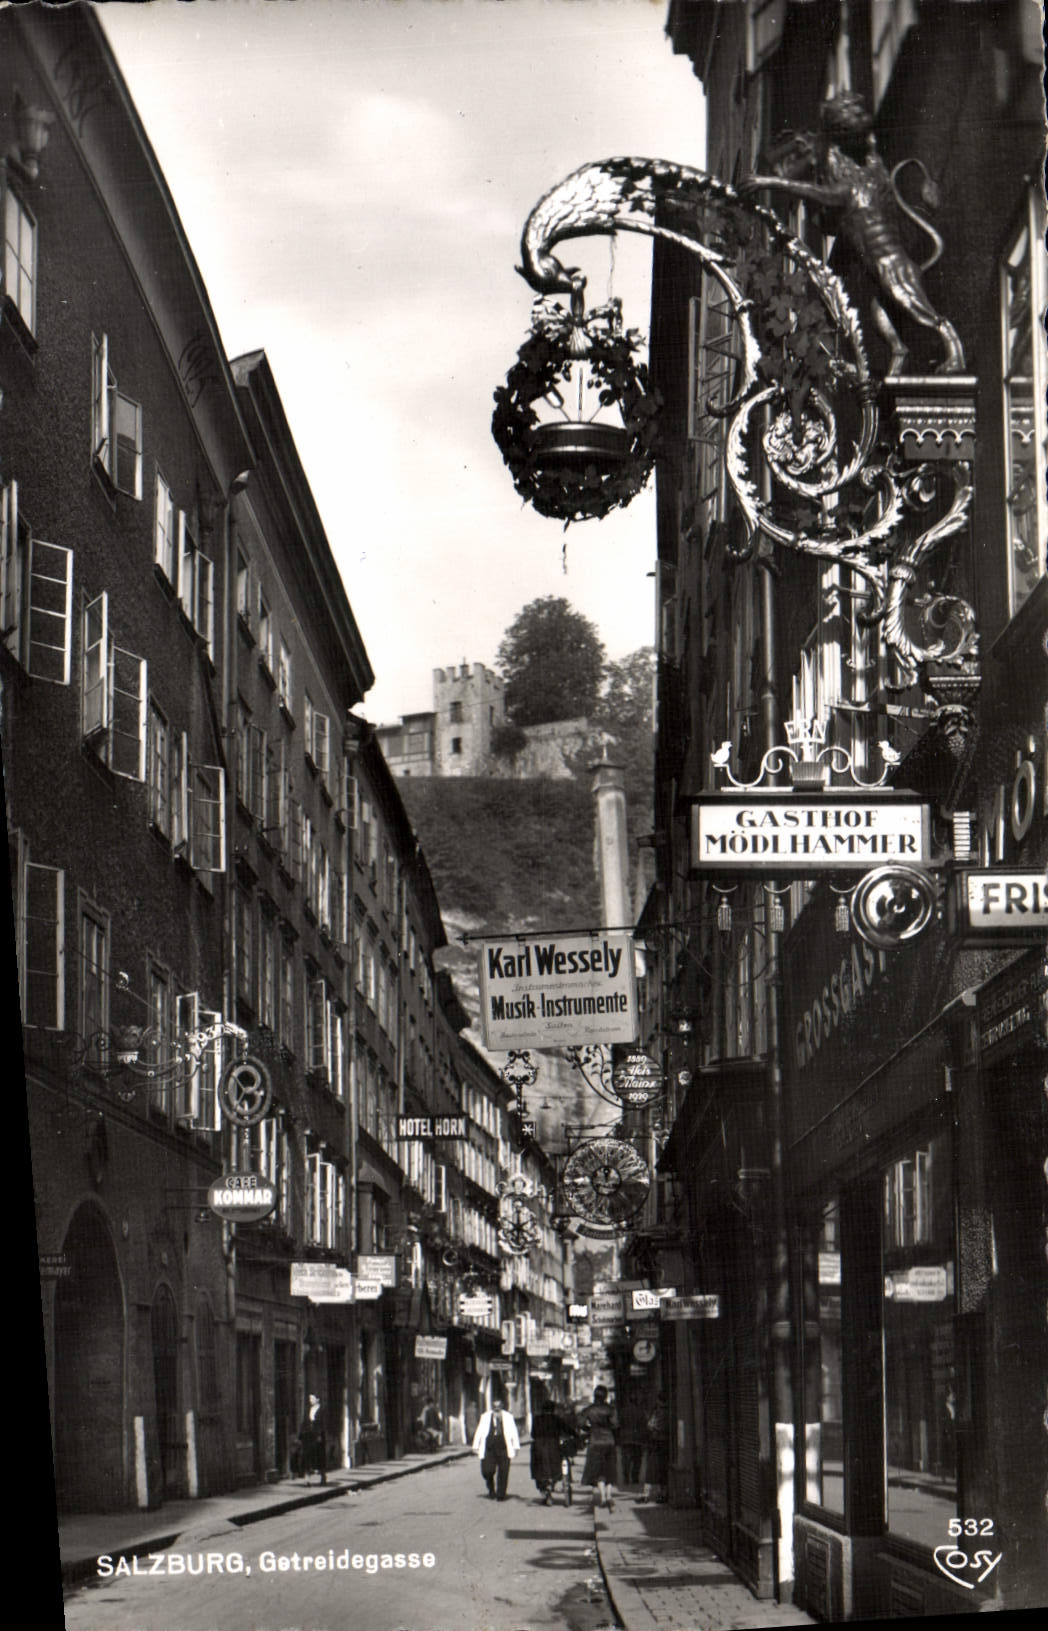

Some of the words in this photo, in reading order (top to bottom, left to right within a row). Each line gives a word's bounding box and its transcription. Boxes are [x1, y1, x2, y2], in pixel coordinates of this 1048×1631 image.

[735, 810, 878, 828] GASTHOF
[705, 829, 918, 855] MÖDLHAMMER
[488, 945, 532, 979] Karl
[534, 940, 622, 978] Wessely
[399, 1117, 433, 1136] HOTEL
[435, 1117, 466, 1136] HORN
